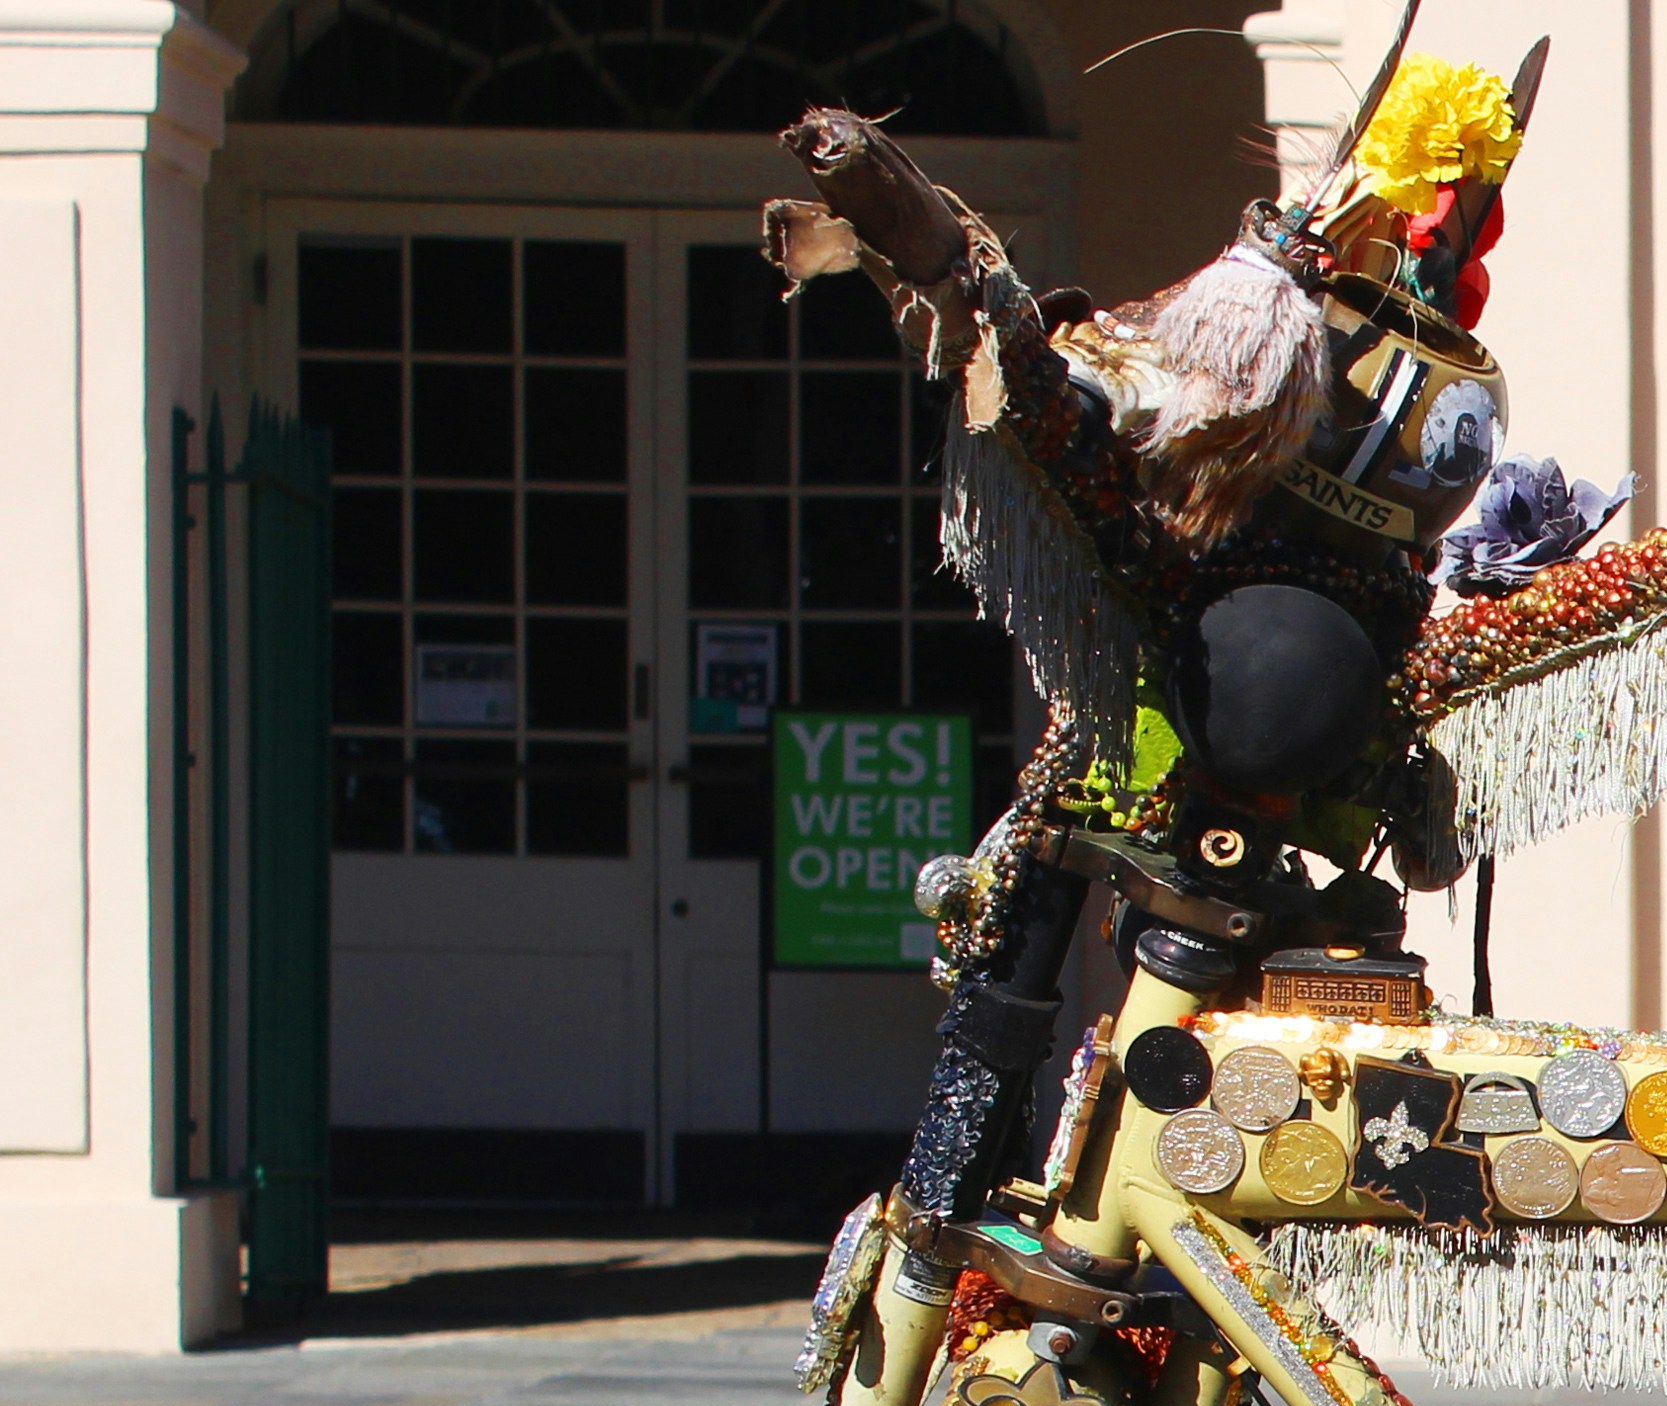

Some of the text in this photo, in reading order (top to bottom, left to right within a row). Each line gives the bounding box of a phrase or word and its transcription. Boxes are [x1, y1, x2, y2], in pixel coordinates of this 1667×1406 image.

[1284, 459, 1393, 530] SAINTS
[788, 722, 950, 786] YES!
[790, 793, 953, 838] WE'RE
[788, 846, 953, 890] OPEN
